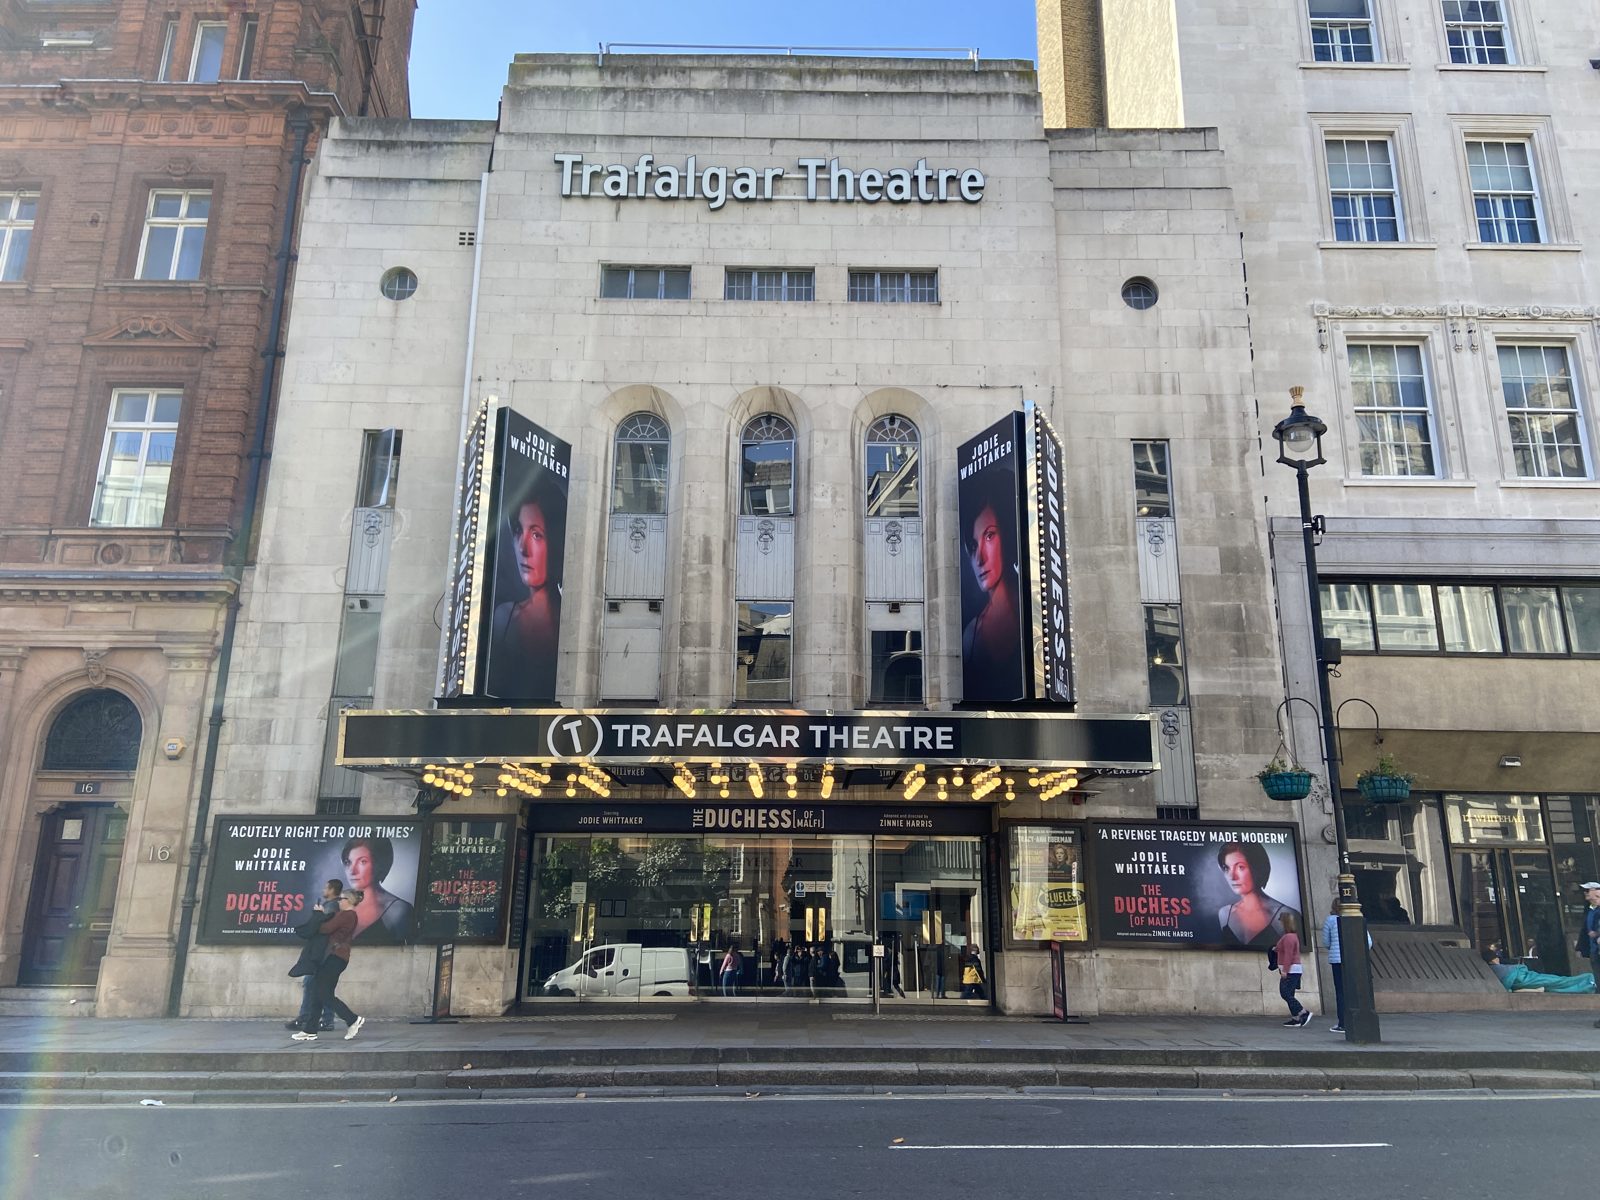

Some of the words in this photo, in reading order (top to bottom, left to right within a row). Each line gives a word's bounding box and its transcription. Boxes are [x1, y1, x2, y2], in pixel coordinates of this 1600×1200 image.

[554, 153, 784, 211] Trafalgar
[798, 157, 986, 204] Theatre
[525, 431, 556, 457] JODIE
[971, 433, 999, 459] JODIE
[510, 434, 568, 479] WHITTAKER
[960, 440, 1012, 480] WHITTAKER
[1046, 460, 1066, 662] DUCHESS
[562, 720, 583, 754] T
[612, 724, 800, 748] TRAFALGAR
[808, 725, 954, 750] THEATRE
[81, 782, 93, 793] 16
[578, 817, 600, 825] JODIE
[602, 817, 643, 825] WHITTAKER
[692, 808, 704, 828] THE
[704, 808, 792, 829] DUCHESS
[880, 819, 904, 827] ZINNIE
[906, 820, 933, 828] HARRIS
[1474, 814, 1529, 823] WHITEHALL
[284, 826, 318, 838] RIGHT
[322, 826, 344, 838] FOR
[349, 826, 371, 838] OUR
[1111, 829, 1157, 841] REVENGE
[1160, 830, 1206, 842] TRAGEDY
[1209, 831, 1238, 843] MADE
[455, 837, 484, 845] JODIE
[149, 846, 170, 861] 16
[253, 848, 291, 859] JODIE
[441, 845, 497, 854] WHITTAKER
[1131, 851, 1167, 862] JODIE
[234, 860, 306, 871] WHITTAKER
[1115, 863, 1185, 875] WHITTAKER
[458, 869, 475, 879] THE
[257, 881, 278, 893] THE
[431, 880, 497, 895] DUCHESS
[1141, 884, 1161, 896] THE
[225, 893, 305, 911] DUCHESS
[1114, 896, 1192, 915] DUCHESS
